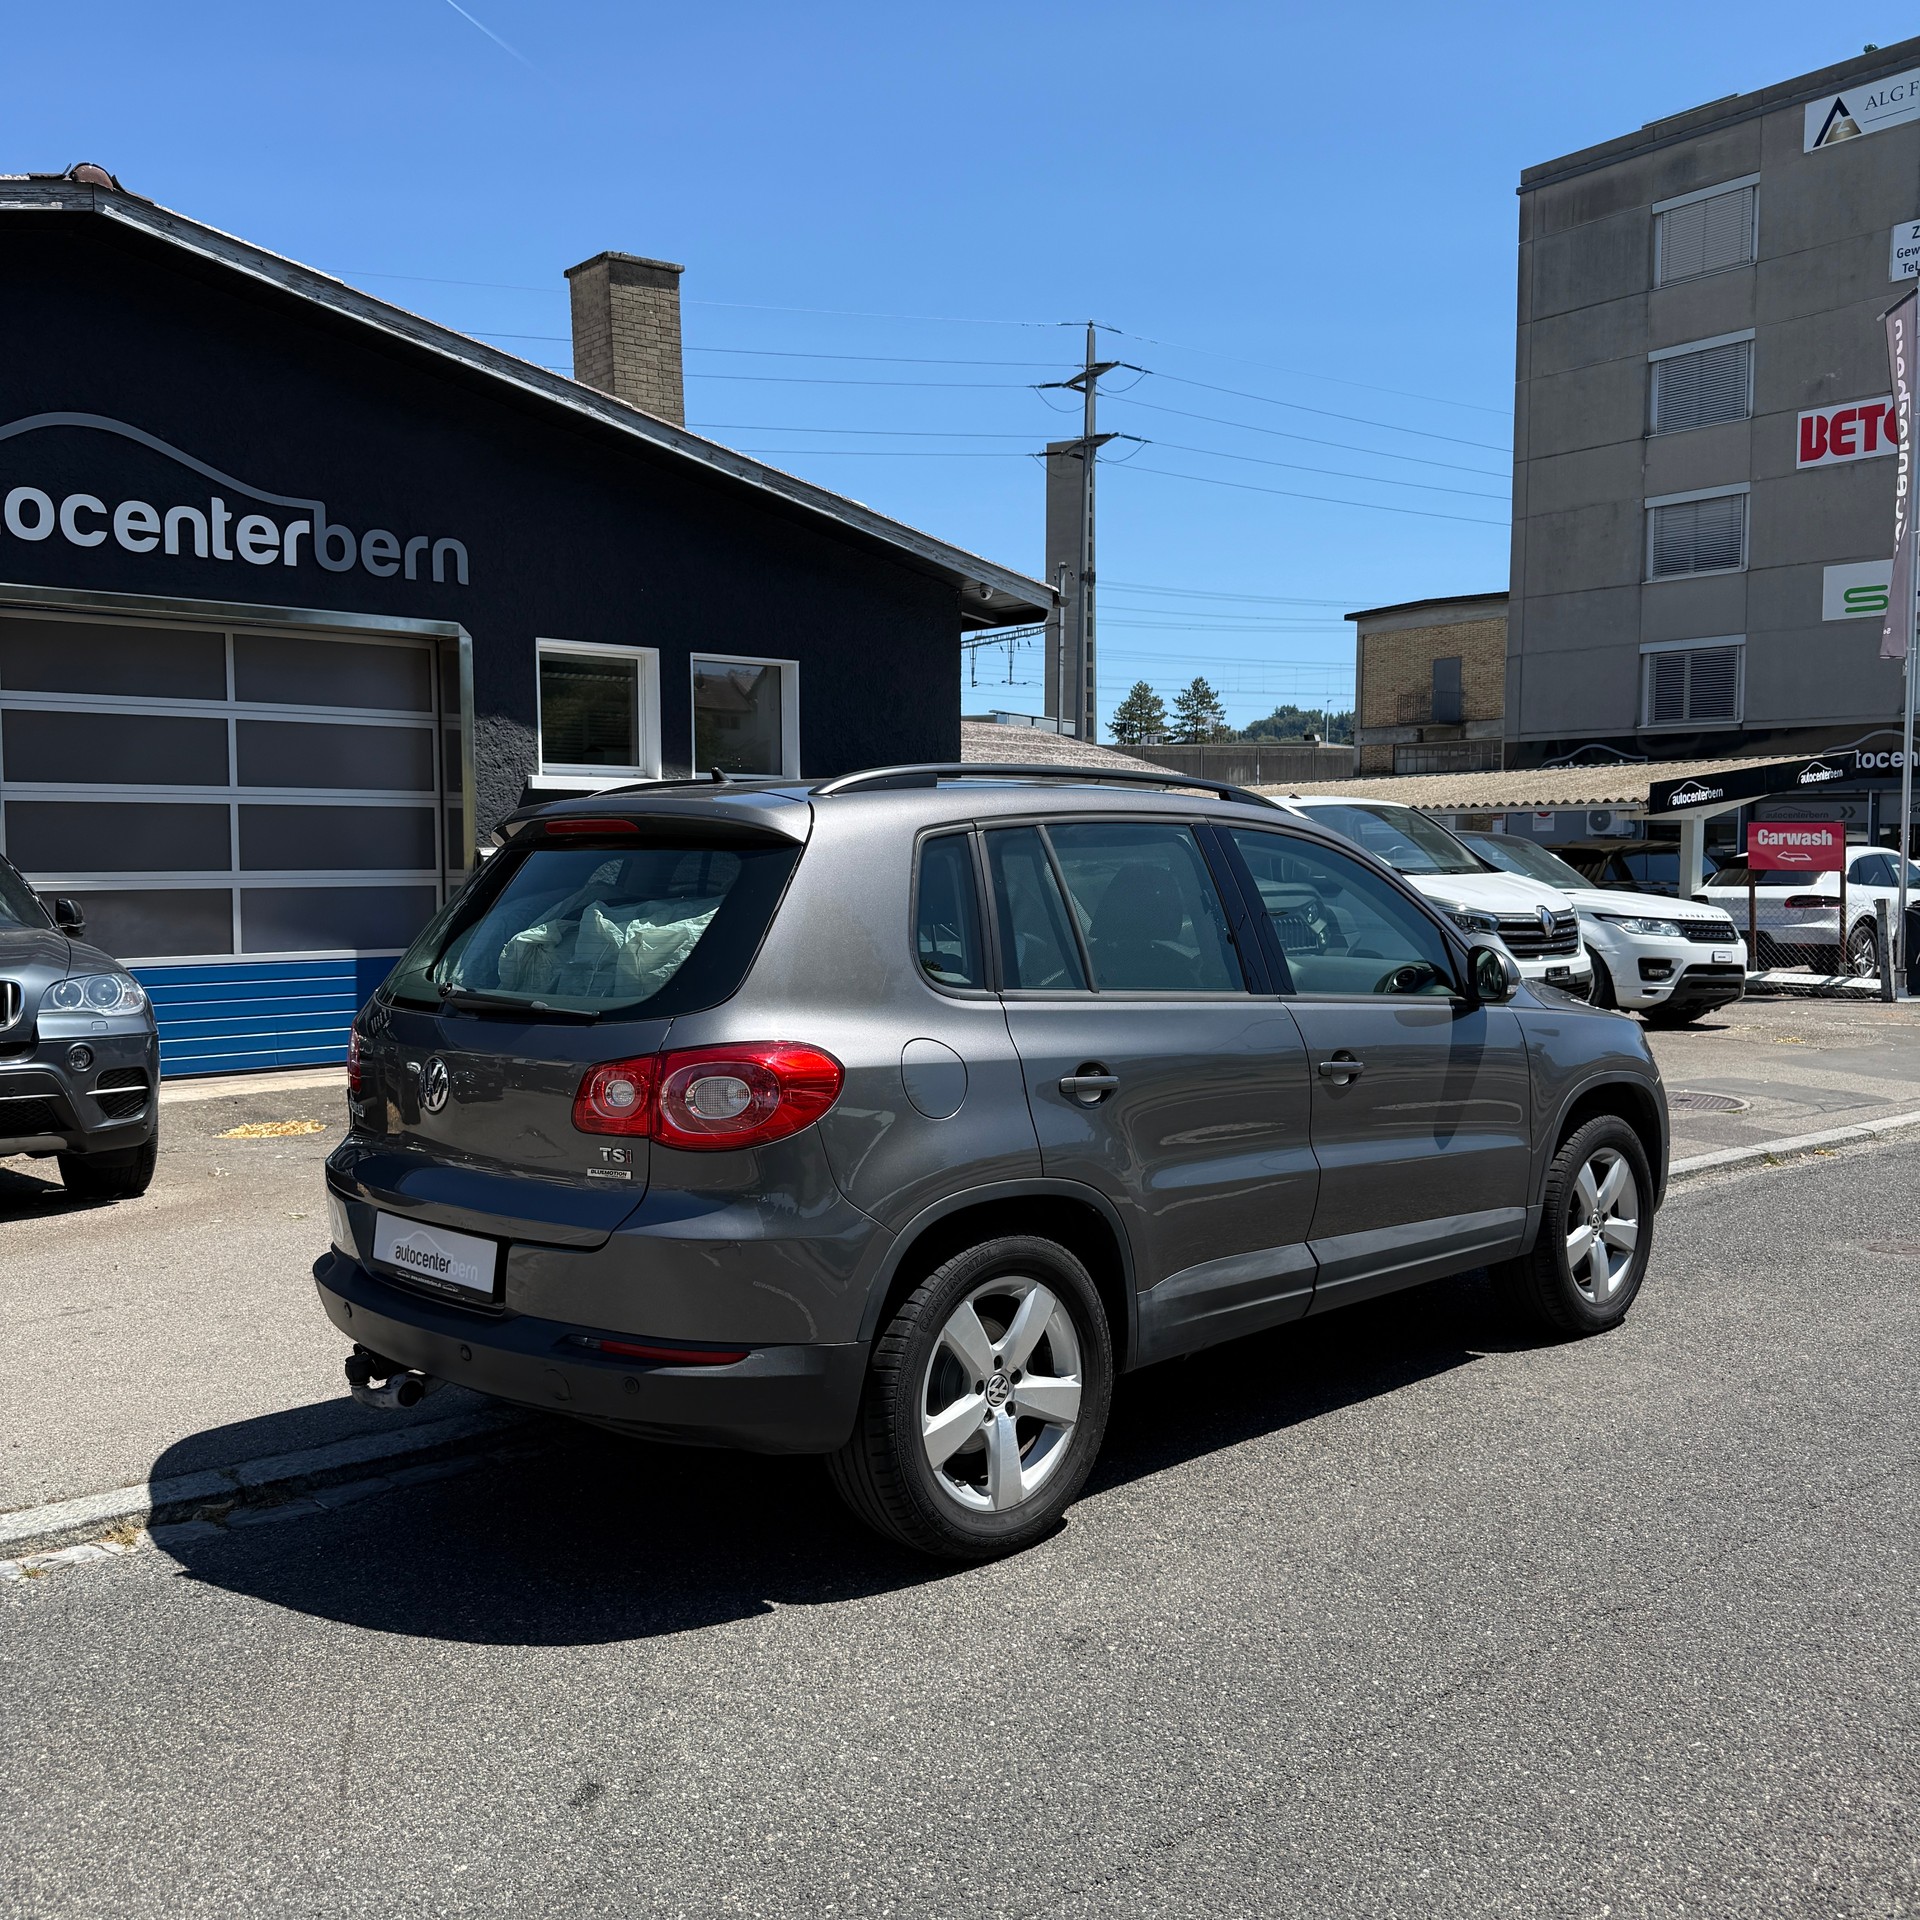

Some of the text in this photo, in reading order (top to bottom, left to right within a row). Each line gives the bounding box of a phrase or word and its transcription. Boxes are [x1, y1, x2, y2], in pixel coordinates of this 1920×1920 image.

[1864, 85, 1904, 111] ALG
[0, 486, 470, 586] ocenterbern
[1800, 769, 1844, 784] autocenterbern
[1672, 788, 1724, 806] autocenterbern
[1757, 829, 1833, 846] Carwash
[600, 1146, 632, 1164] TSI
[395, 1244, 479, 1281] autocenterbern
